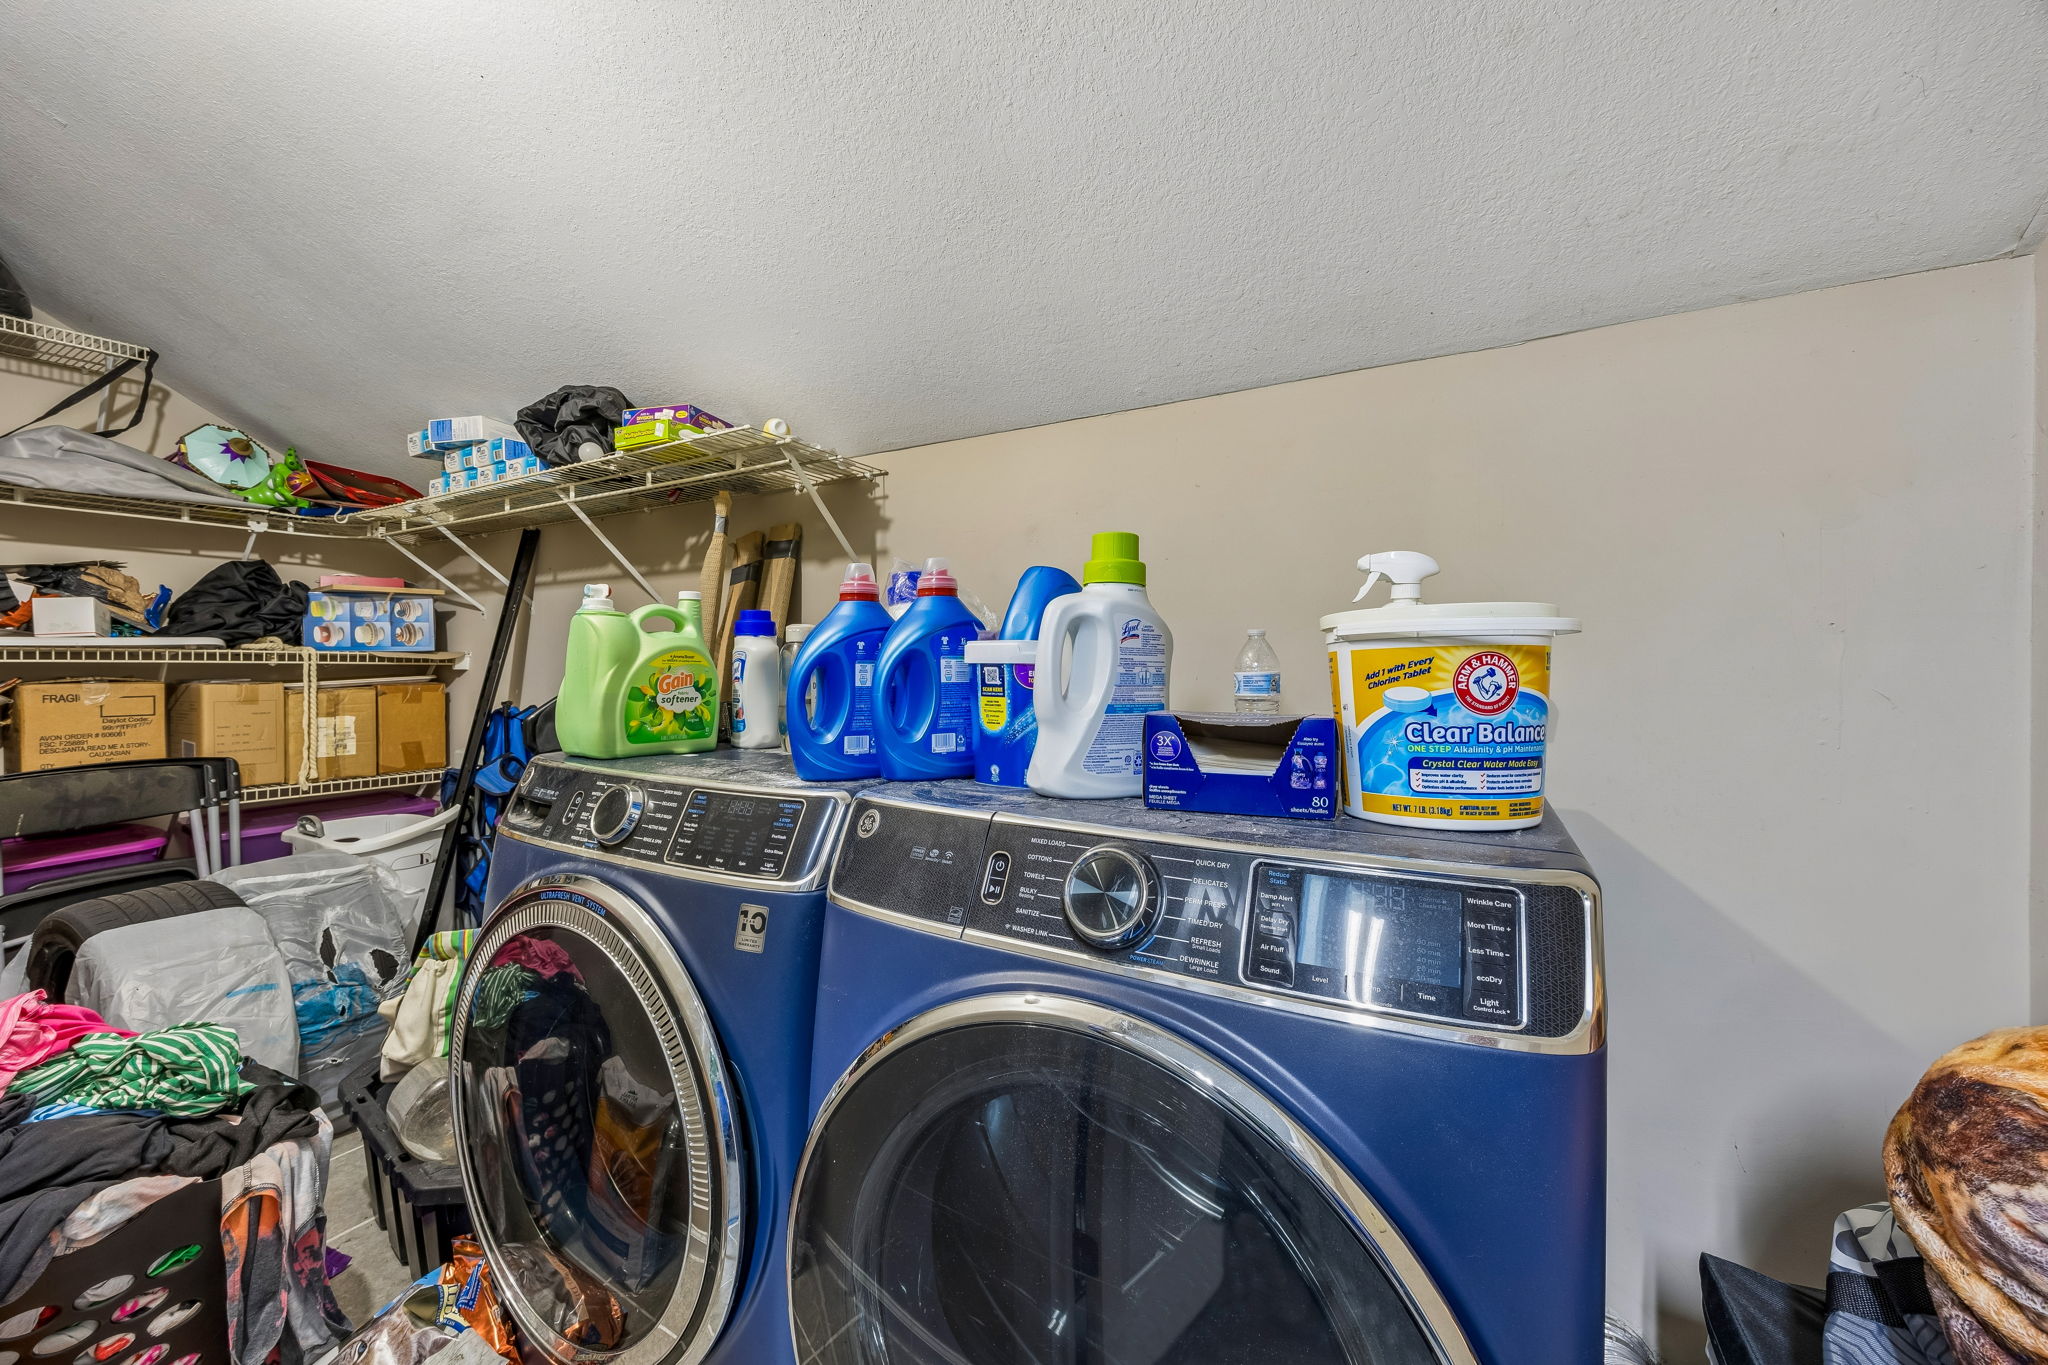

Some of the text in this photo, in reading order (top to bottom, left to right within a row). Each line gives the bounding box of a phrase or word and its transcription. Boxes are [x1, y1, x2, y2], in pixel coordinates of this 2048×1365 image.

[1122, 619, 1141, 636] Lysol
[1365, 670, 1380, 681] Add
[1387, 664, 1405, 675] with
[1408, 656, 1435, 670] Every
[1458, 664, 1474, 690] ARM
[1471, 659, 1482, 668] &
[1482, 655, 1516, 689] HAMMER
[1368, 666, 1432, 689] Chlorine Tablet
[658, 672, 694, 695] Gain
[661, 694, 698, 706] softener
[1405, 721, 1545, 744] Clear Balance
[1407, 745, 1426, 753] ONE
[1428, 745, 1451, 753] STEP
[1454, 745, 1494, 754] Alkalinity
[1502, 745, 1513, 754] pH
[1422, 759, 1538, 768] Crystal Clear Water Made Easy
[1312, 796, 1328, 808] 80
[1290, 806, 1328, 814] sheets/feuilles
[1392, 803, 1402, 811] NET
[1403, 804, 1412, 812] WT.
[1419, 805, 1427, 813] LB.
[1428, 806, 1453, 816] (3.18kg)
[1031, 837, 1066, 847] MIXED LOADS
[1027, 853, 1053, 862] COTTONS
[1195, 859, 1231, 869] QUICK DRY
[1024, 871, 1045, 880] TOWELS
[1268, 870, 1290, 878] Reduce
[1193, 877, 1228, 889] DELICATES
[1269, 877, 1287, 886] Static
[1020, 886, 1037, 894] BULKY
[1018, 892, 1034, 900] Bedding
[1260, 892, 1293, 902] Damp Alert
[540, 891, 606, 917] ULTRAFRESH VENT SYSTEM
[1184, 896, 1226, 909] PERM PRESS
[1466, 897, 1512, 909] Wrinkle Care
[1015, 907, 1040, 917] SANITIZE
[740, 909, 766, 934] 10
[1188, 918, 1223, 929] TIMED DRY
[1260, 915, 1290, 926] Delay Dry
[1012, 925, 1048, 937] WASHER LINK
[1260, 923, 1276, 931] Remote
[1467, 921, 1485, 930] More
[1486, 923, 1505, 932] Time
[738, 941, 760, 949] WARRANTY
[1191, 936, 1222, 948] REFRESH
[1206, 945, 1221, 953] Loads
[1260, 943, 1284, 953] Air Fluff
[1468, 947, 1504, 958] Less Time
[1179, 954, 1219, 968] DEWRINKLE
[1189, 964, 1218, 975] Large Loads
[1260, 965, 1280, 975] Sound
[1311, 975, 1329, 984] Level
[1476, 974, 1503, 984] ecoDry
[1417, 992, 1436, 1002] Time
[1480, 998, 1499, 1007] Light
[1473, 1005, 1493, 1013] Control
